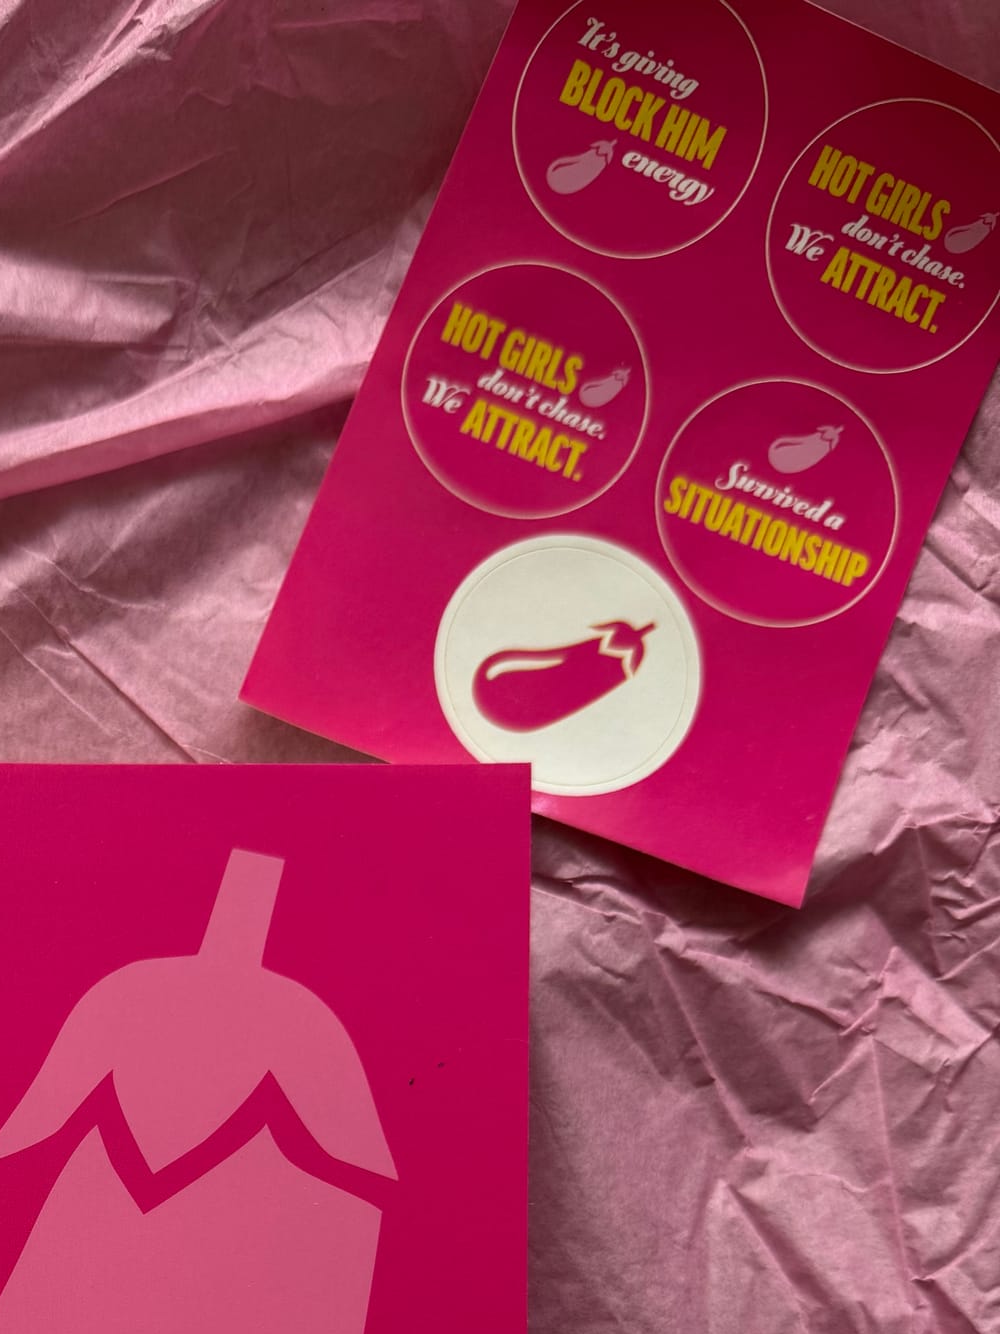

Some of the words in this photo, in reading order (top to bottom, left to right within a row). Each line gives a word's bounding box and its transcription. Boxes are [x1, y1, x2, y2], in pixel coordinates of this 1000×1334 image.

[578, 17, 620, 65] It's
[613, 50, 699, 100] giving
[559, 59, 666, 141] BLOCK
[655, 105, 727, 170] HIM
[621, 151, 715, 206] energy
[808, 145, 875, 203] HOT
[866, 173, 950, 240] GIRLS
[785, 223, 834, 261] We
[820, 247, 946, 334] ATTRACT.
[841, 214, 905, 256] don't
[900, 244, 964, 289] chase.
[442, 304, 506, 359] HOT
[499, 330, 583, 396] GIRLS
[422, 376, 471, 414] We
[460, 399, 588, 482] ATTRACT.
[477, 368, 541, 409] don't
[537, 395, 605, 440] chase.
[663, 476, 870, 586] SITUATIONSHIP
[714, 461, 834, 522] Survived
[821, 511, 846, 532] a
